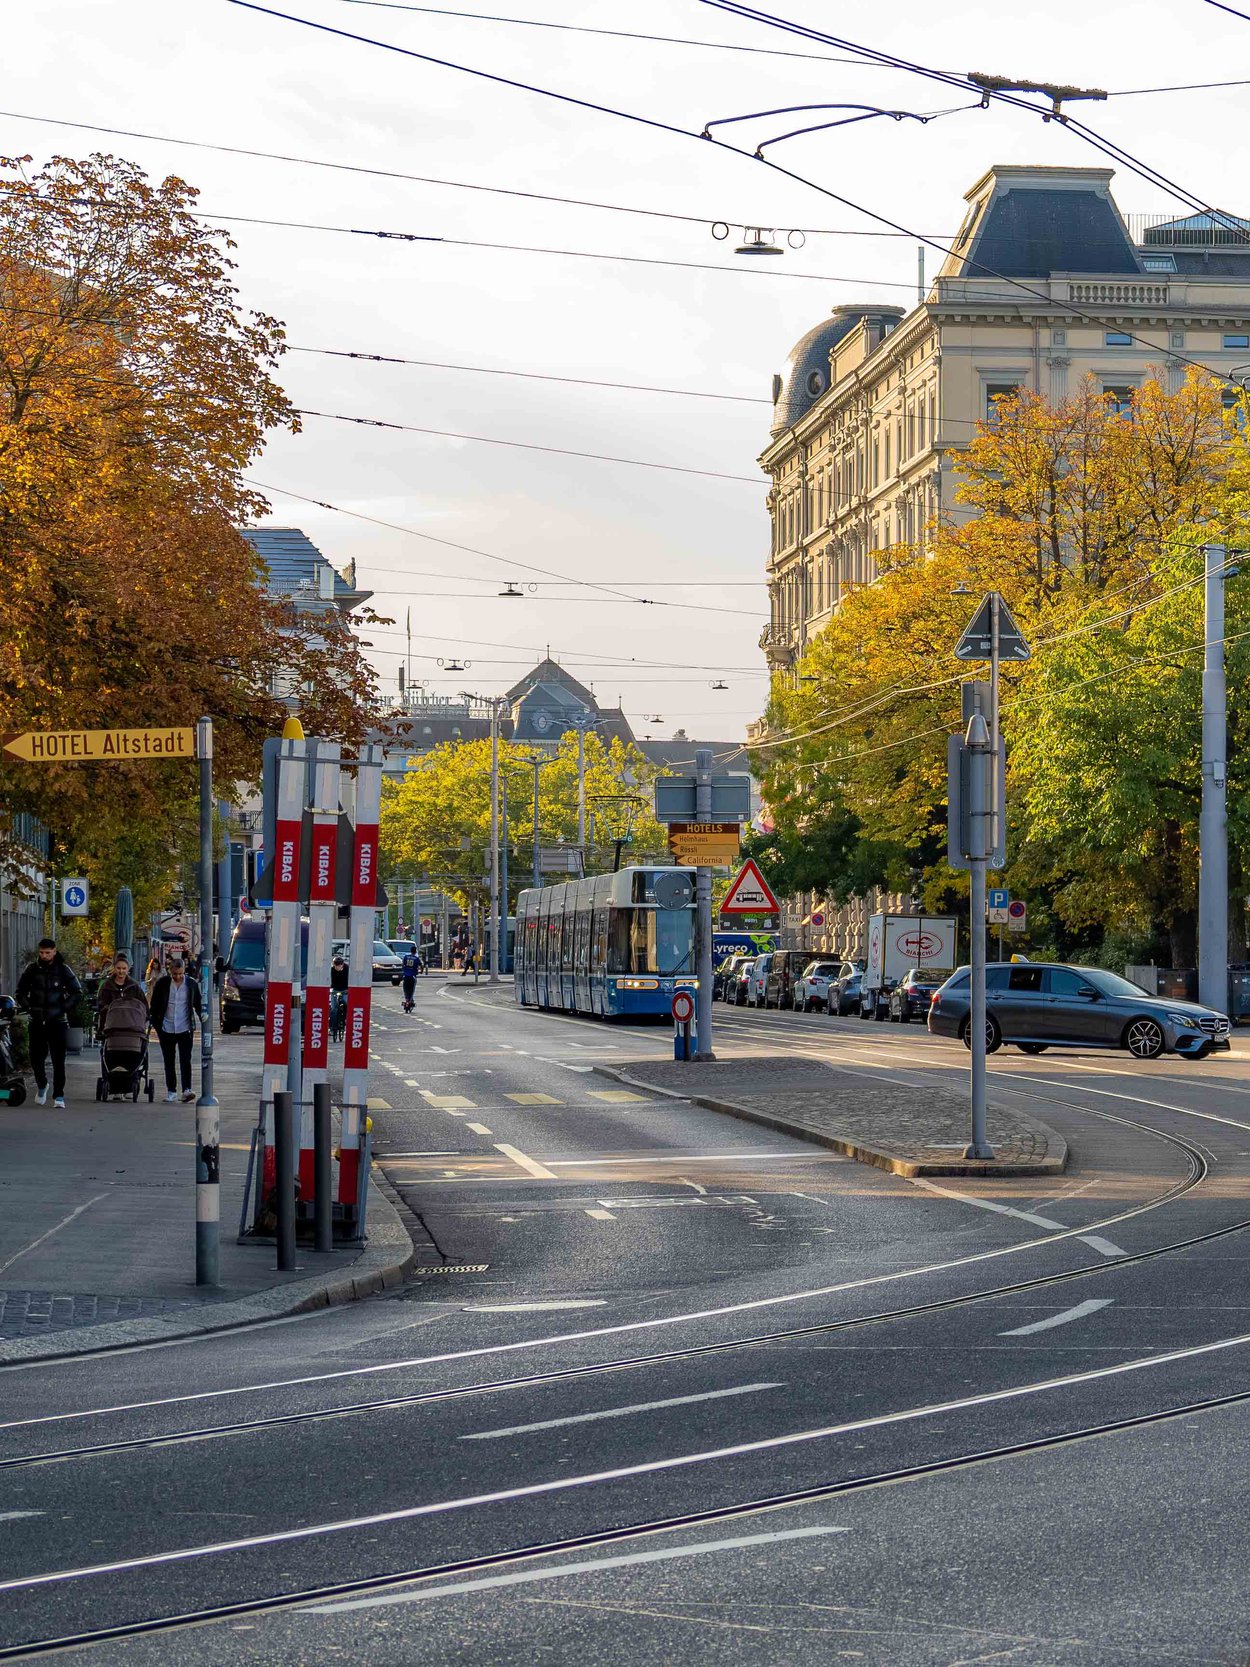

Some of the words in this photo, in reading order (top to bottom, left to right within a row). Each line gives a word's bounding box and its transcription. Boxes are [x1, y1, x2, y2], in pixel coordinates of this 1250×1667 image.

[32, 735, 93, 757] HOTEL
[103, 731, 184, 755] Altstadt
[687, 824, 723, 833] HOTELS
[281, 841, 294, 882] KIBAG
[318, 845, 330, 886] KIBAG
[360, 844, 371, 884] KIBAG
[687, 856, 723, 864] California
[272, 1004, 284, 1045] KIBAG
[311, 1007, 323, 1049] KIBAG
[352, 1007, 363, 1049] KIBAG
